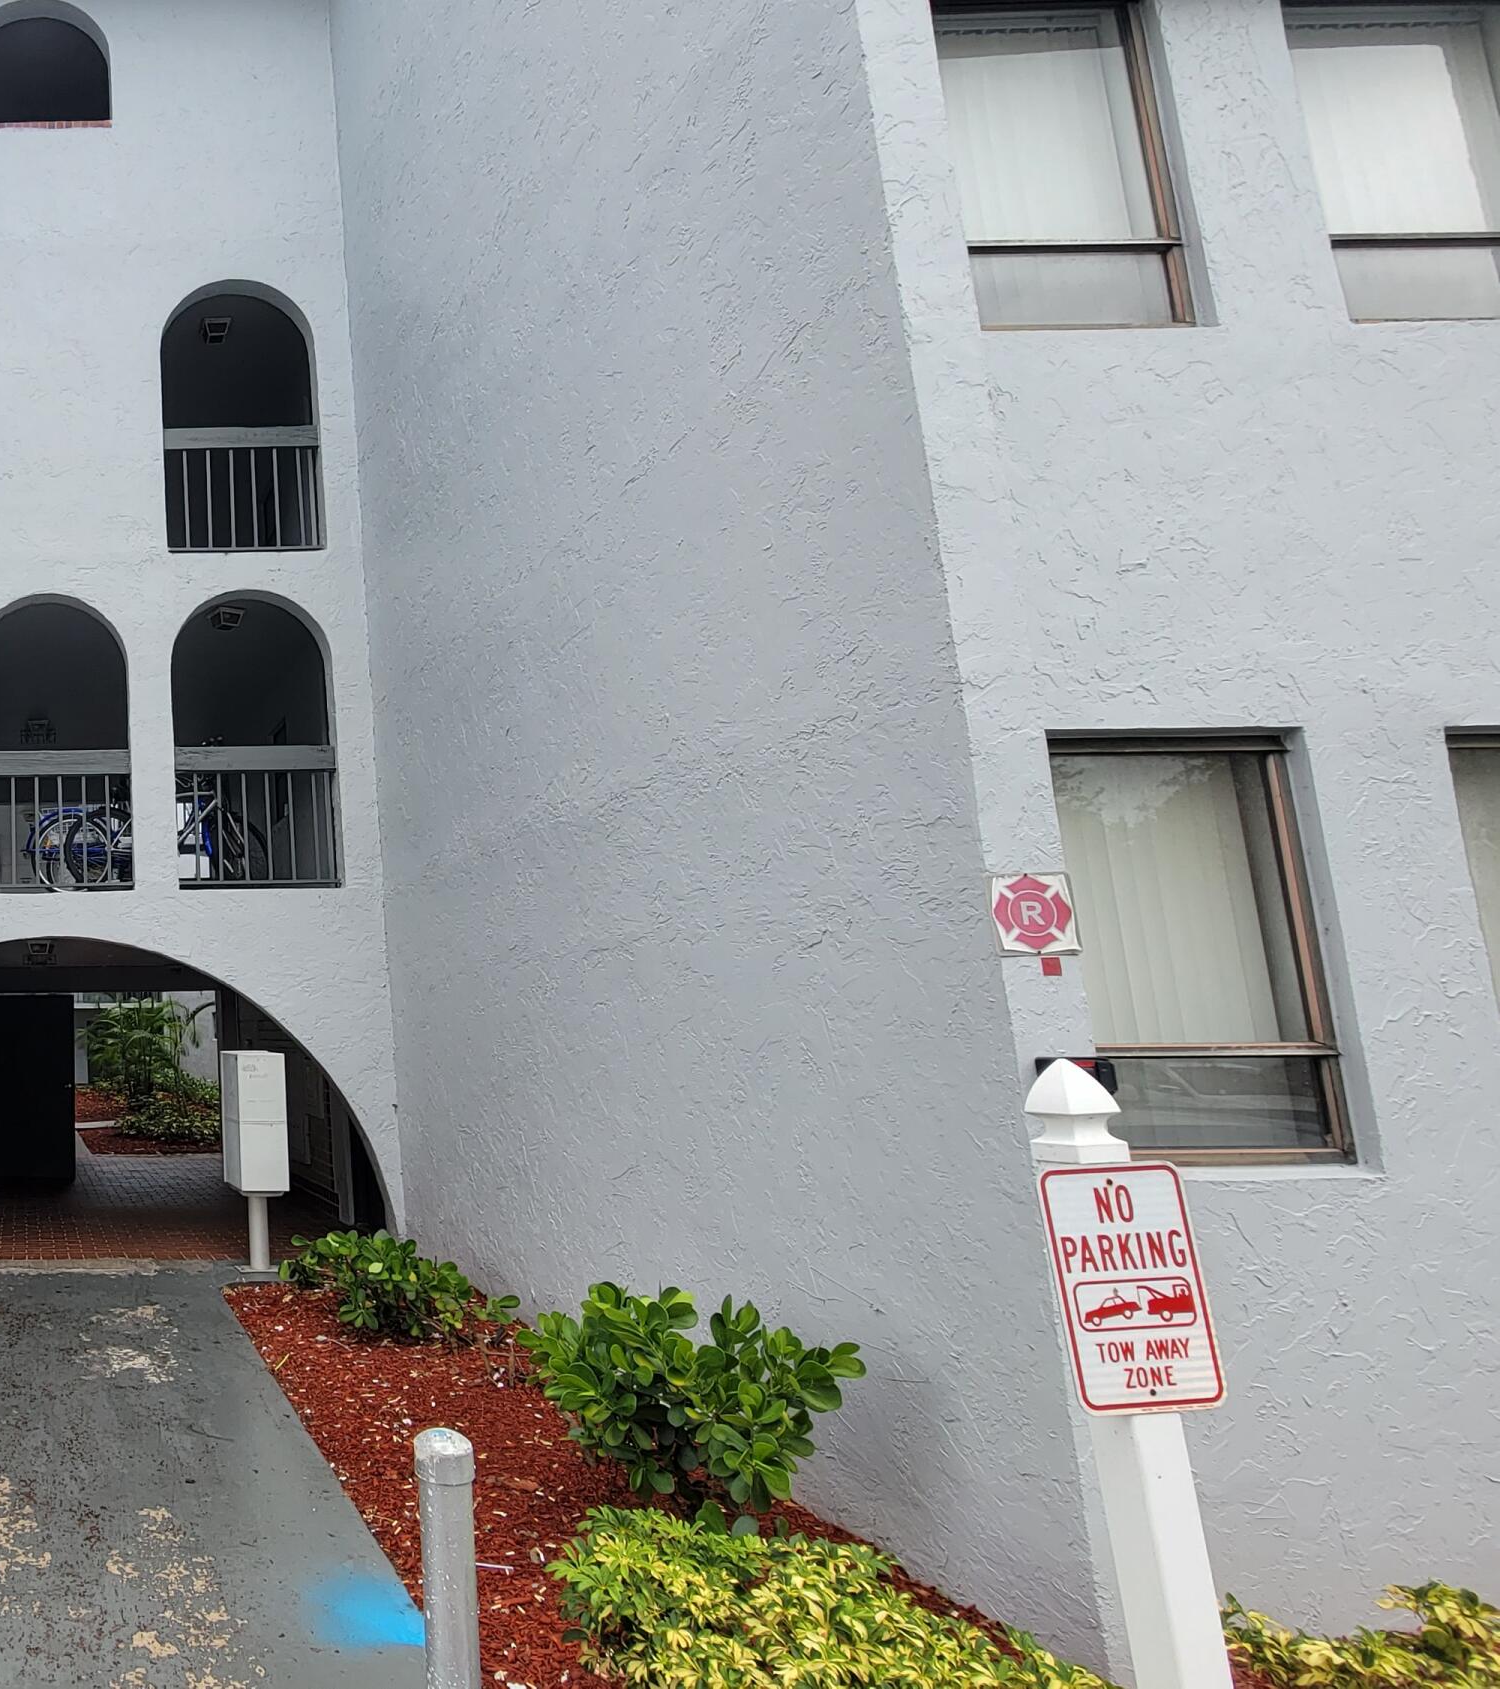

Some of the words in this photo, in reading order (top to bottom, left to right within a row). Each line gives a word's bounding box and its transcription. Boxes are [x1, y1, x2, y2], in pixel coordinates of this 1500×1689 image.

[1019, 901, 1046, 925] R
[1093, 1184, 1134, 1224] NO
[1060, 1229, 1187, 1274] PARKING
[1095, 1341, 1135, 1363] TOW
[1145, 1337, 1190, 1361] AWAY
[1123, 1366, 1178, 1389] ZONE
